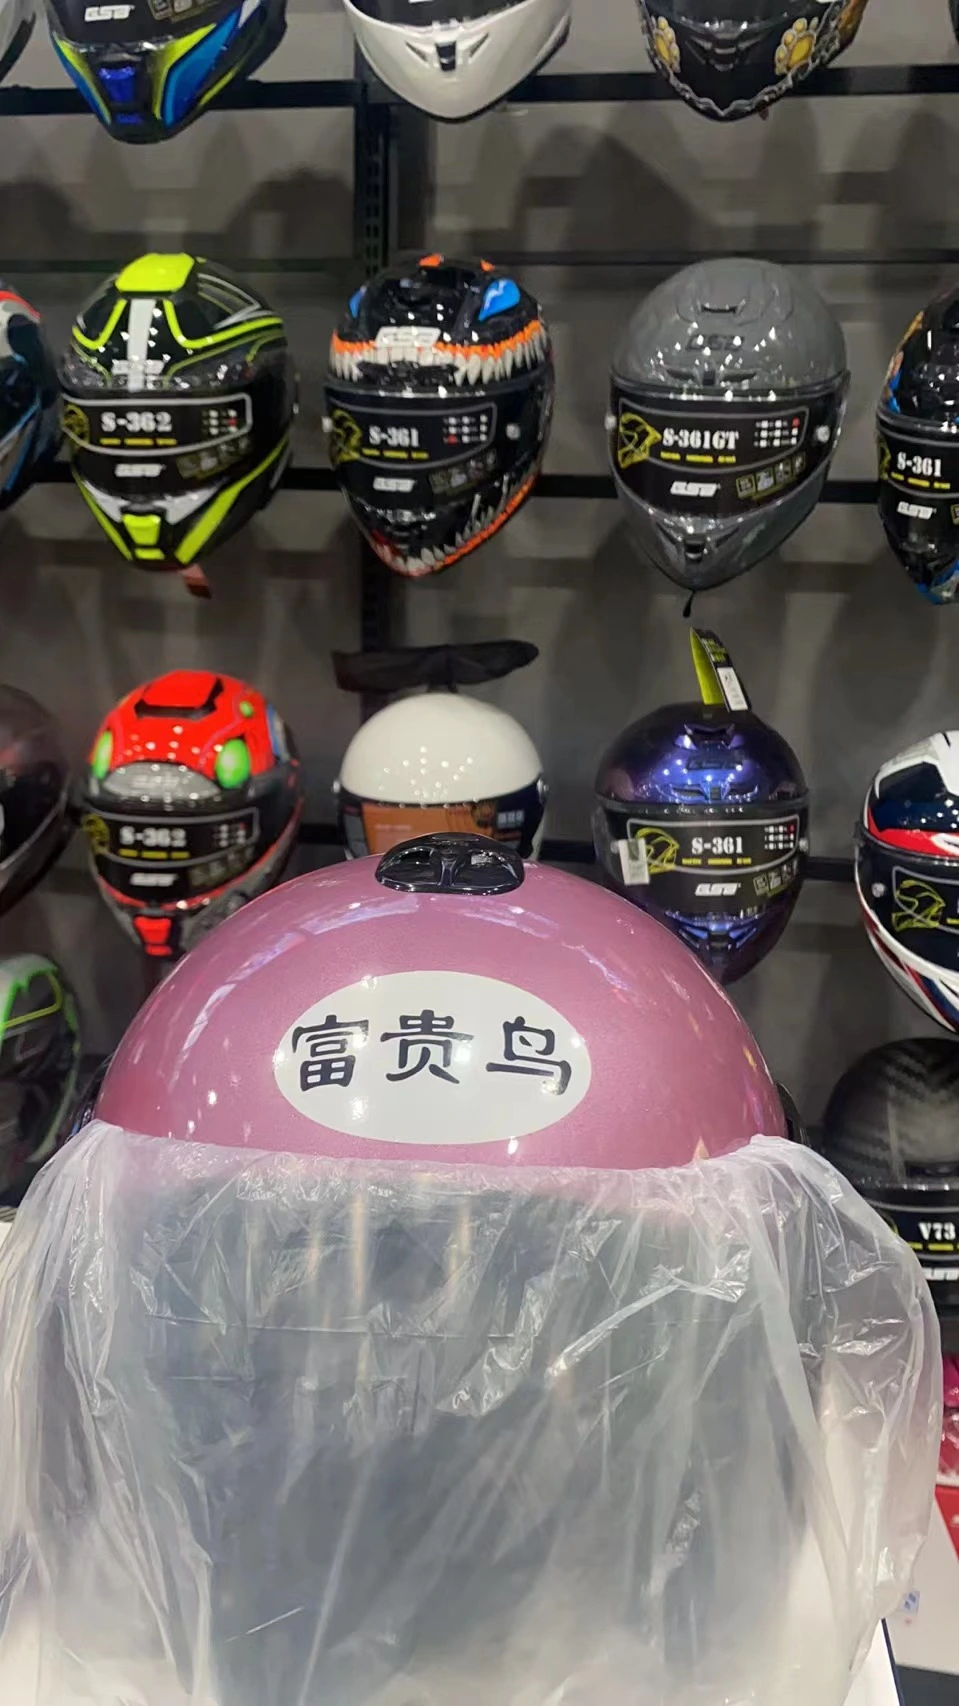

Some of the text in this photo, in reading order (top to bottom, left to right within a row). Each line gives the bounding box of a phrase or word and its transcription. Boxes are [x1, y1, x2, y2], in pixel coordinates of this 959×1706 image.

[101, 411, 173, 432] S-362
[369, 425, 420, 448] S-361
[662, 427, 740, 450] S-361GT
[897, 451, 941, 477] S-361
[691, 836, 744, 855] S-361
[292, 1009, 572, 1095] 富贵鸟
[918, 1222, 956, 1240] V73
